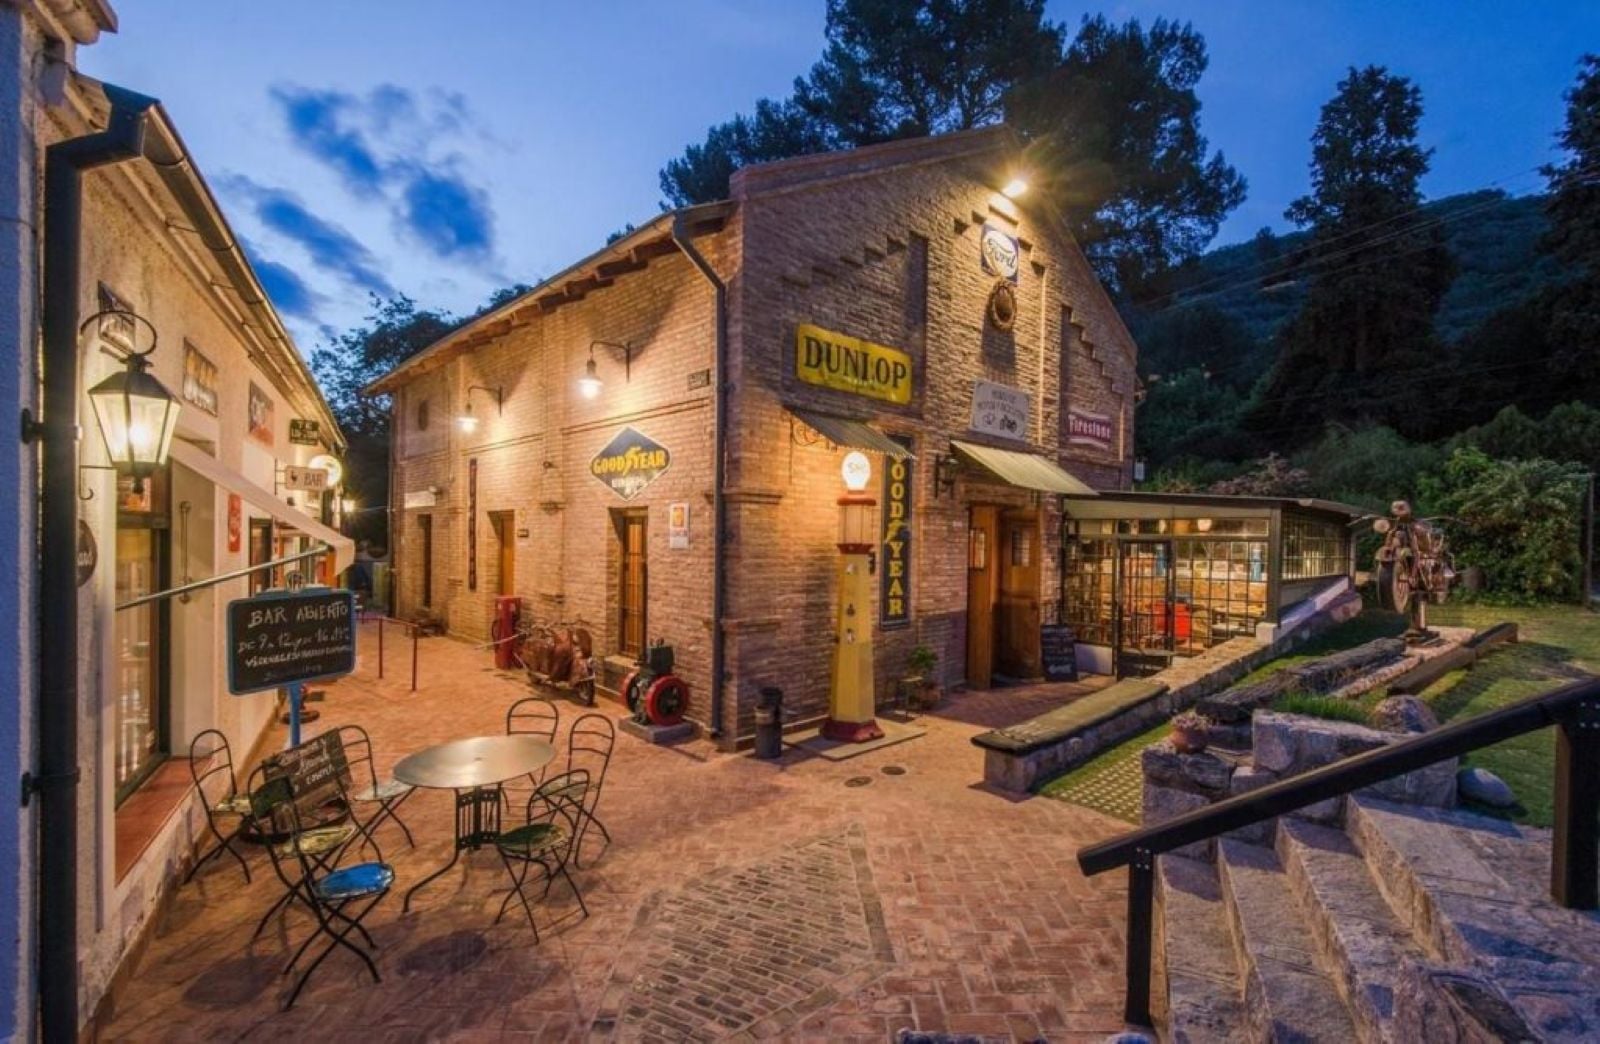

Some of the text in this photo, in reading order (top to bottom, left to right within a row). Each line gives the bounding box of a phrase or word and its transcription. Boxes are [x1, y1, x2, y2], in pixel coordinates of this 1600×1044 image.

[985, 238, 1015, 268] Ford
[803, 336, 907, 388] DUNLOP
[1068, 414, 1110, 439] Firestone
[593, 447, 665, 475] GOODYEAR
[304, 472, 323, 487] BAR
[886, 457, 907, 614] OODYEAR
[248, 602, 348, 628] BAR ABIERTO
